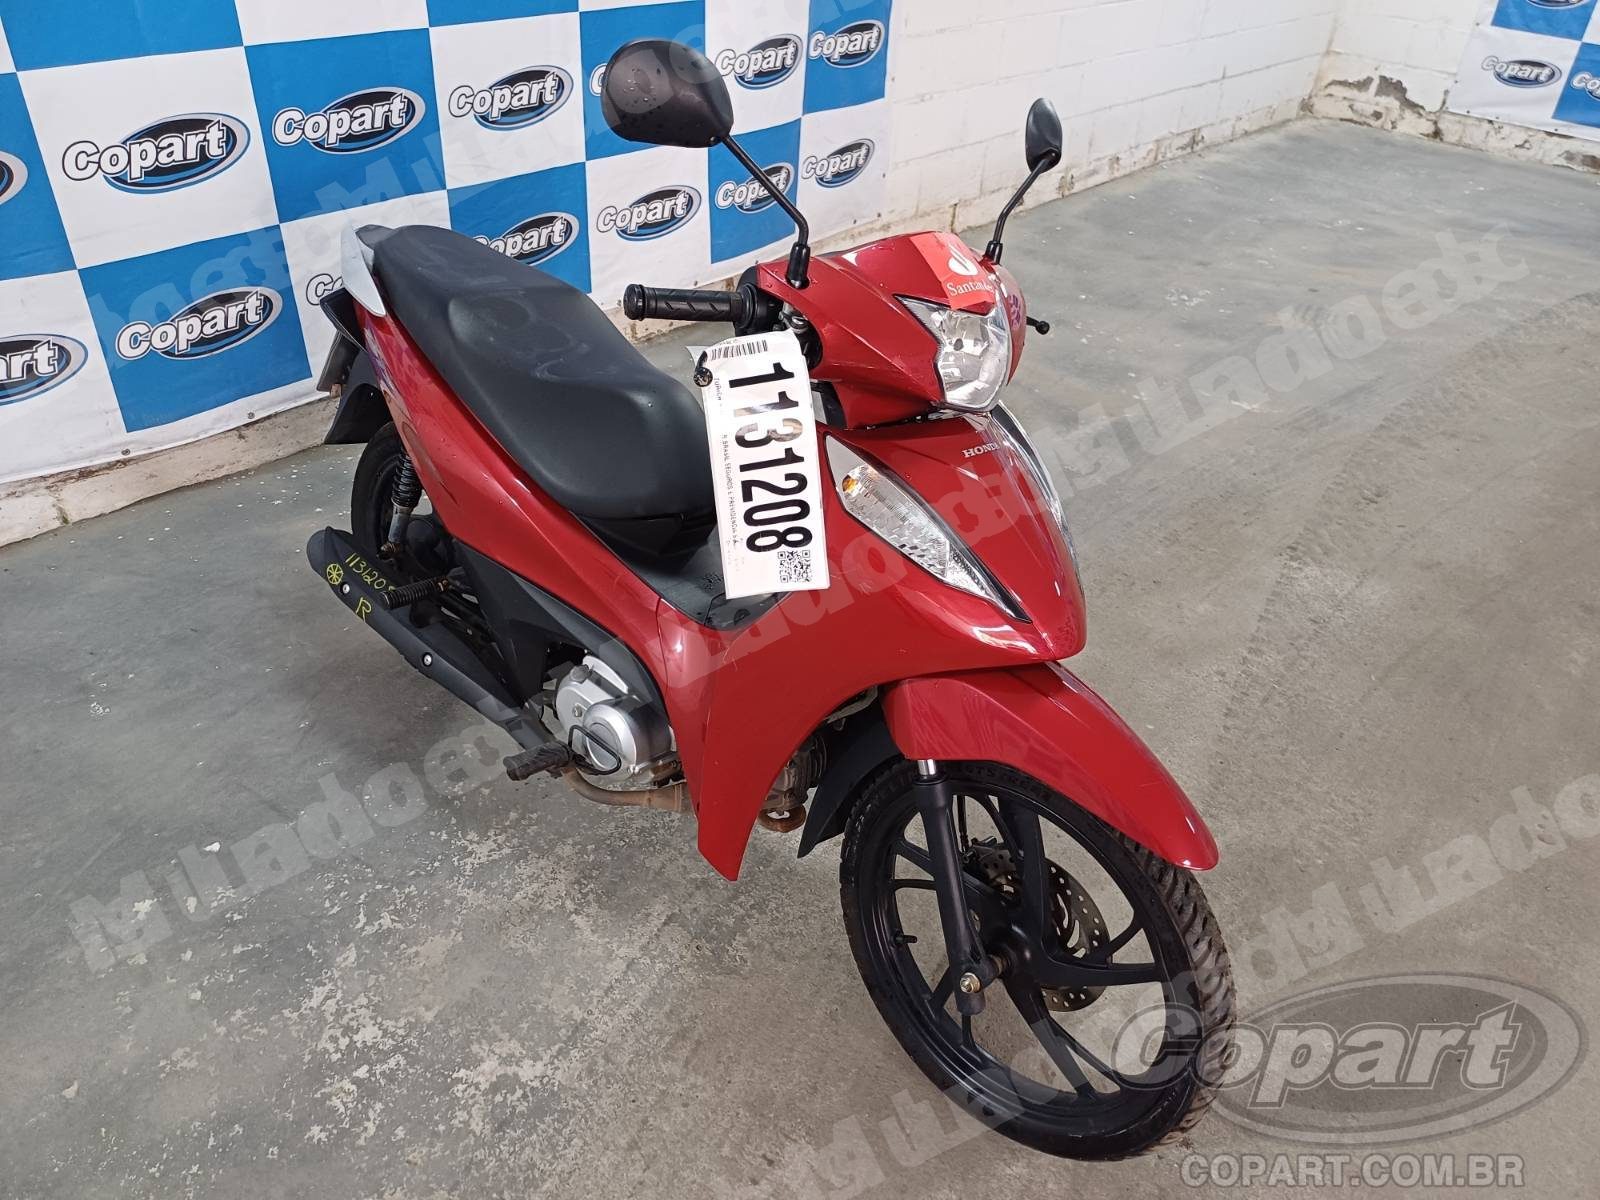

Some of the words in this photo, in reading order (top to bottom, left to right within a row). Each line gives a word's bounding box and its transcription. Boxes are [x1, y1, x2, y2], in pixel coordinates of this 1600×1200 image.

[715, 37, 797, 80] Copart
[809, 23, 881, 59] Copart
[1480, 55, 1554, 83] Copart
[448, 69, 560, 119] Copart
[272, 93, 408, 147] Copart
[62, 119, 230, 182] Copart
[801, 144, 868, 180] Copart
[597, 191, 691, 233] Copart
[116, 286, 266, 360] Copart
[728, 362, 813, 553] 1131208
